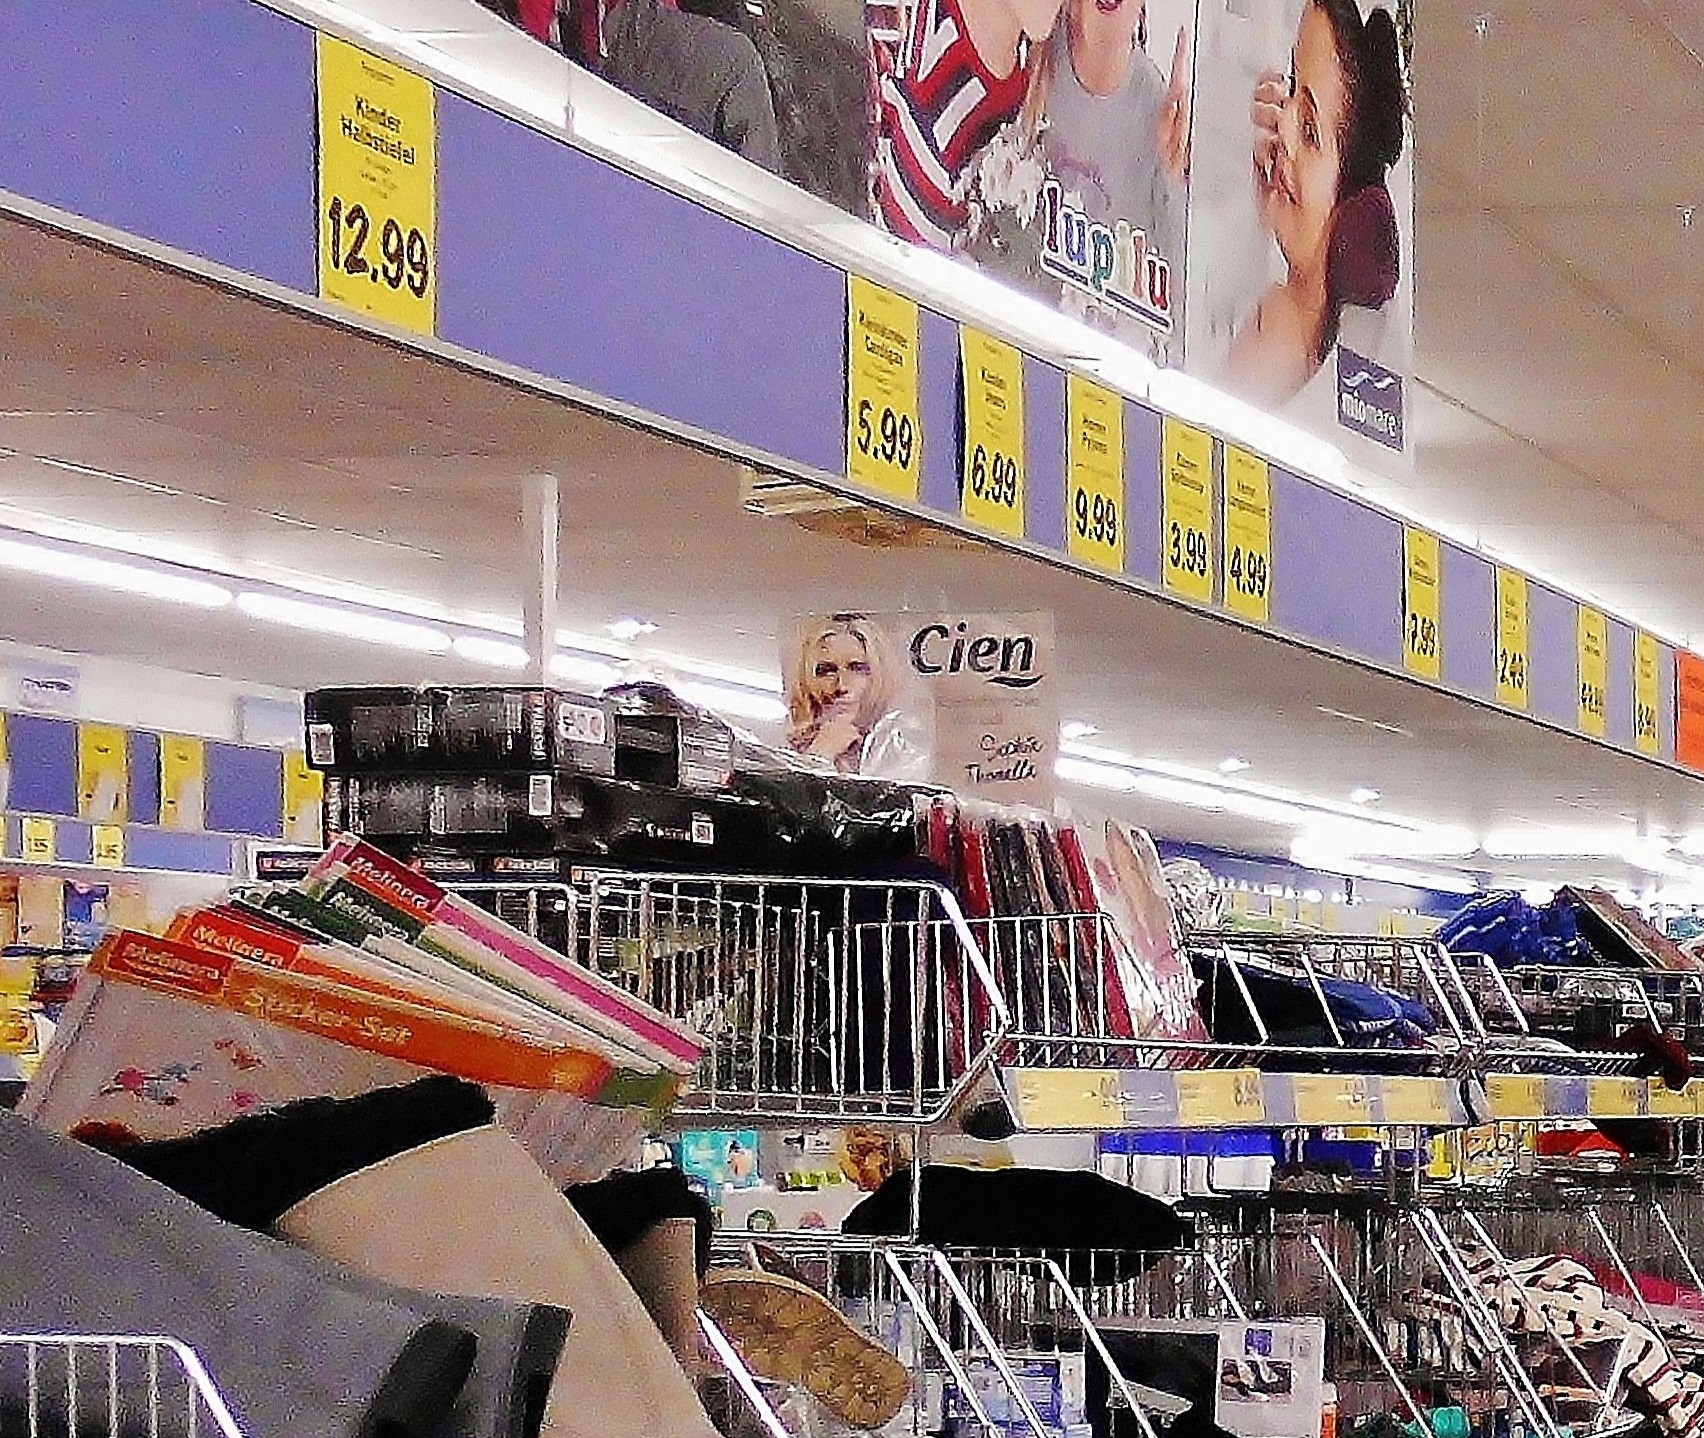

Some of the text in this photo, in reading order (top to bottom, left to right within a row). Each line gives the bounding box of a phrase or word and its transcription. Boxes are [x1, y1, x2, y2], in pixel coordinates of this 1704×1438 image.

[355, 94, 402, 133] Kinder
[330, 197, 428, 298] 12.99
[1042, 177, 1171, 312] lupilu
[857, 400, 914, 470] 5.99
[971, 444, 1018, 509] 6.99
[1074, 487, 1118, 547] 9.99
[1170, 521, 1208, 577] 3.99
[1229, 545, 1267, 598] 4.99
[909, 621, 1038, 676] Cien
